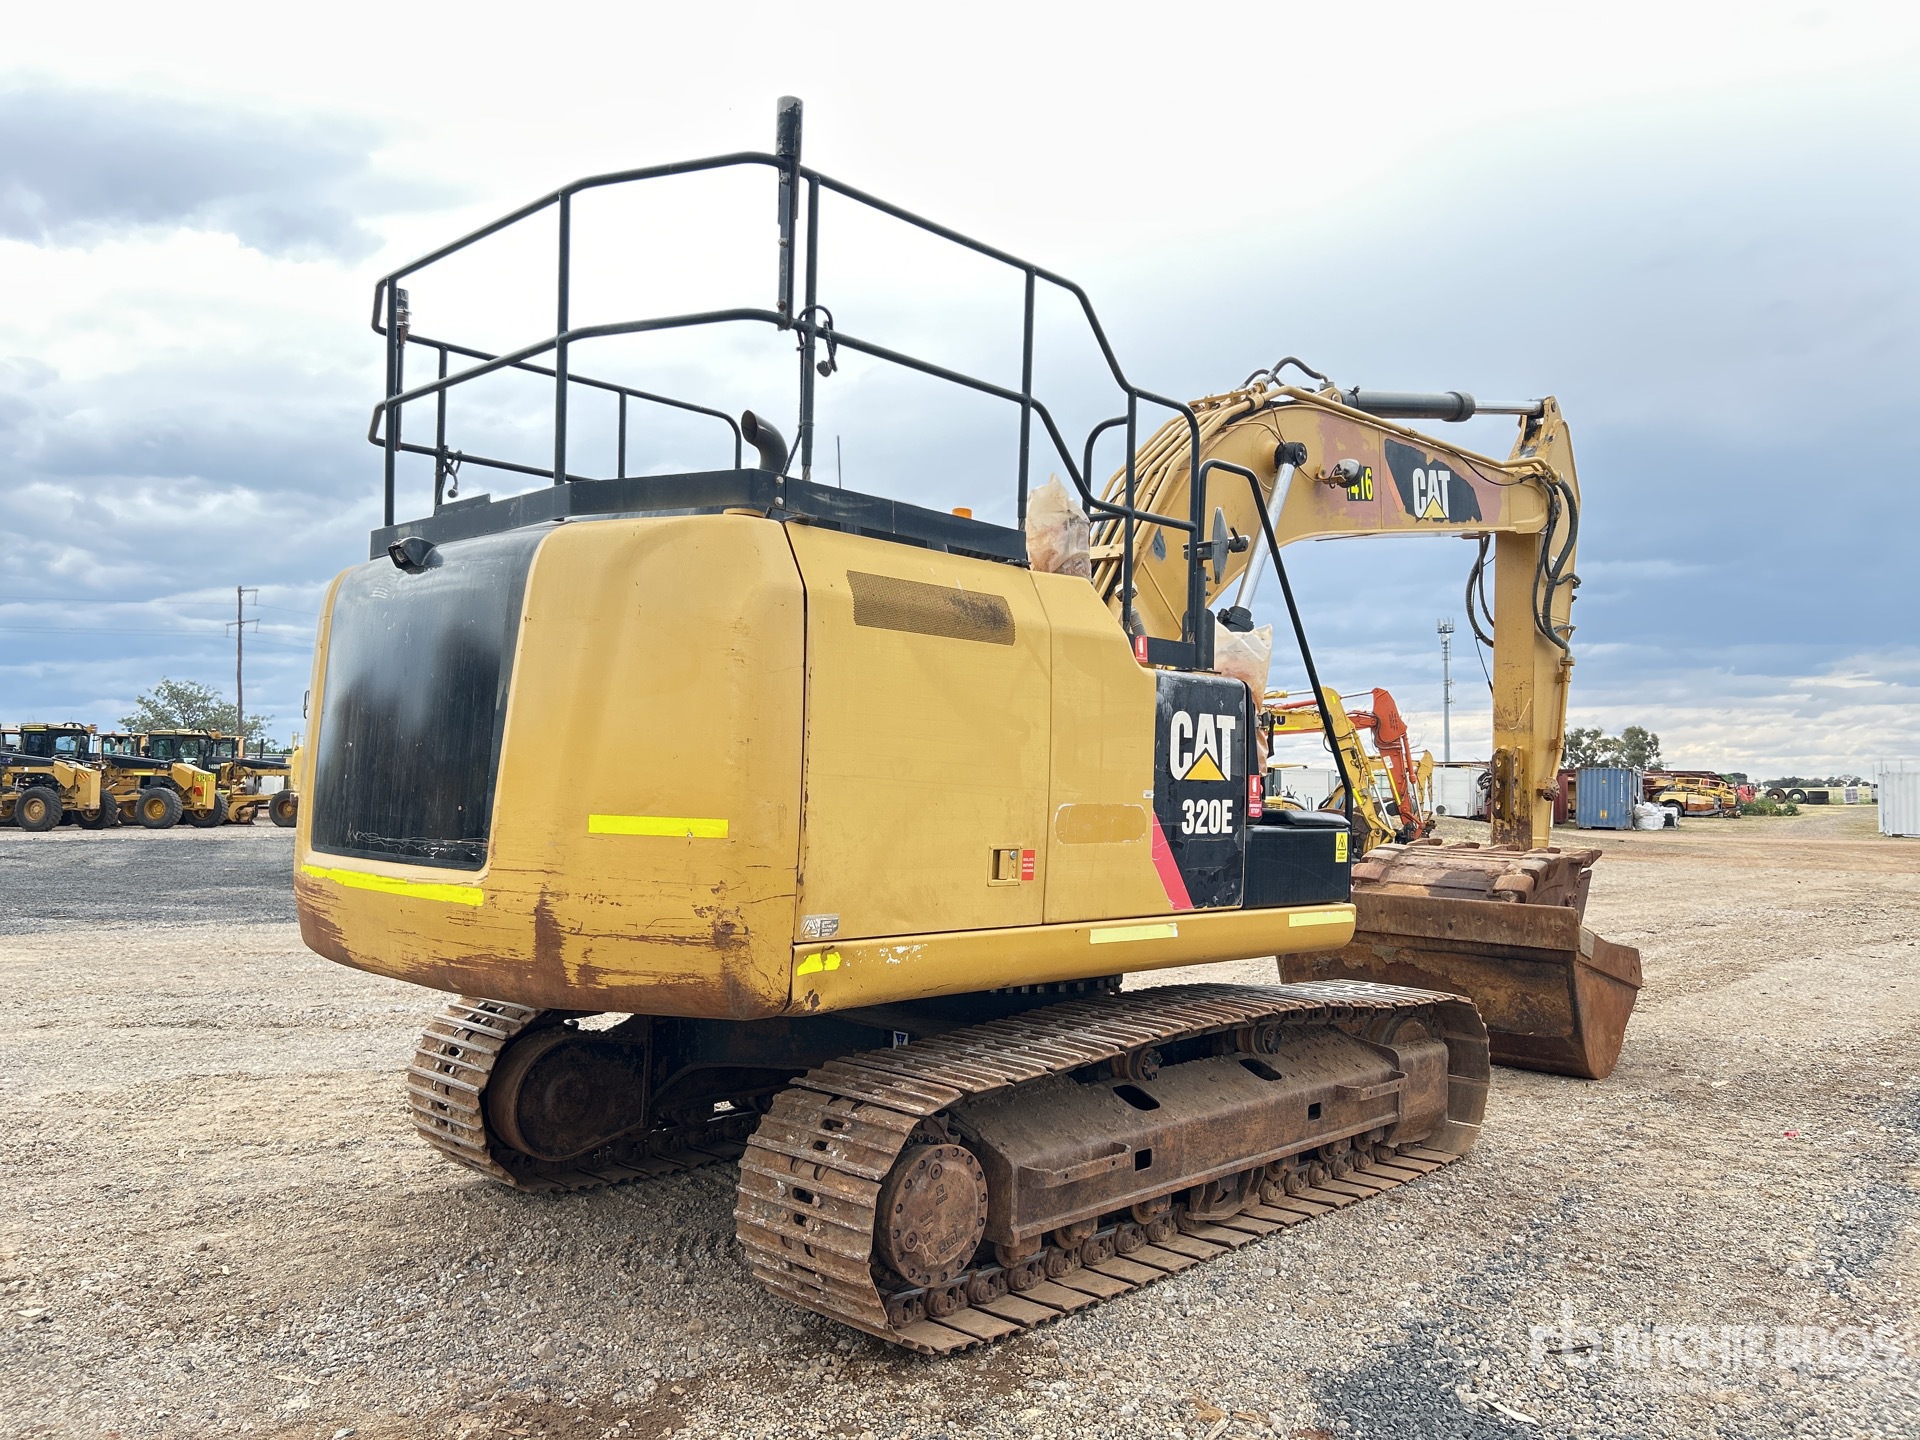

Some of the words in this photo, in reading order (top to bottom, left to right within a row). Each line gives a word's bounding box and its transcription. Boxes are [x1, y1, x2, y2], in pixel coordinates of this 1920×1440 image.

[1413, 468, 1450, 518] CAT
[1170, 711, 1236, 781] CAT
[1181, 799, 1233, 835] 320E
